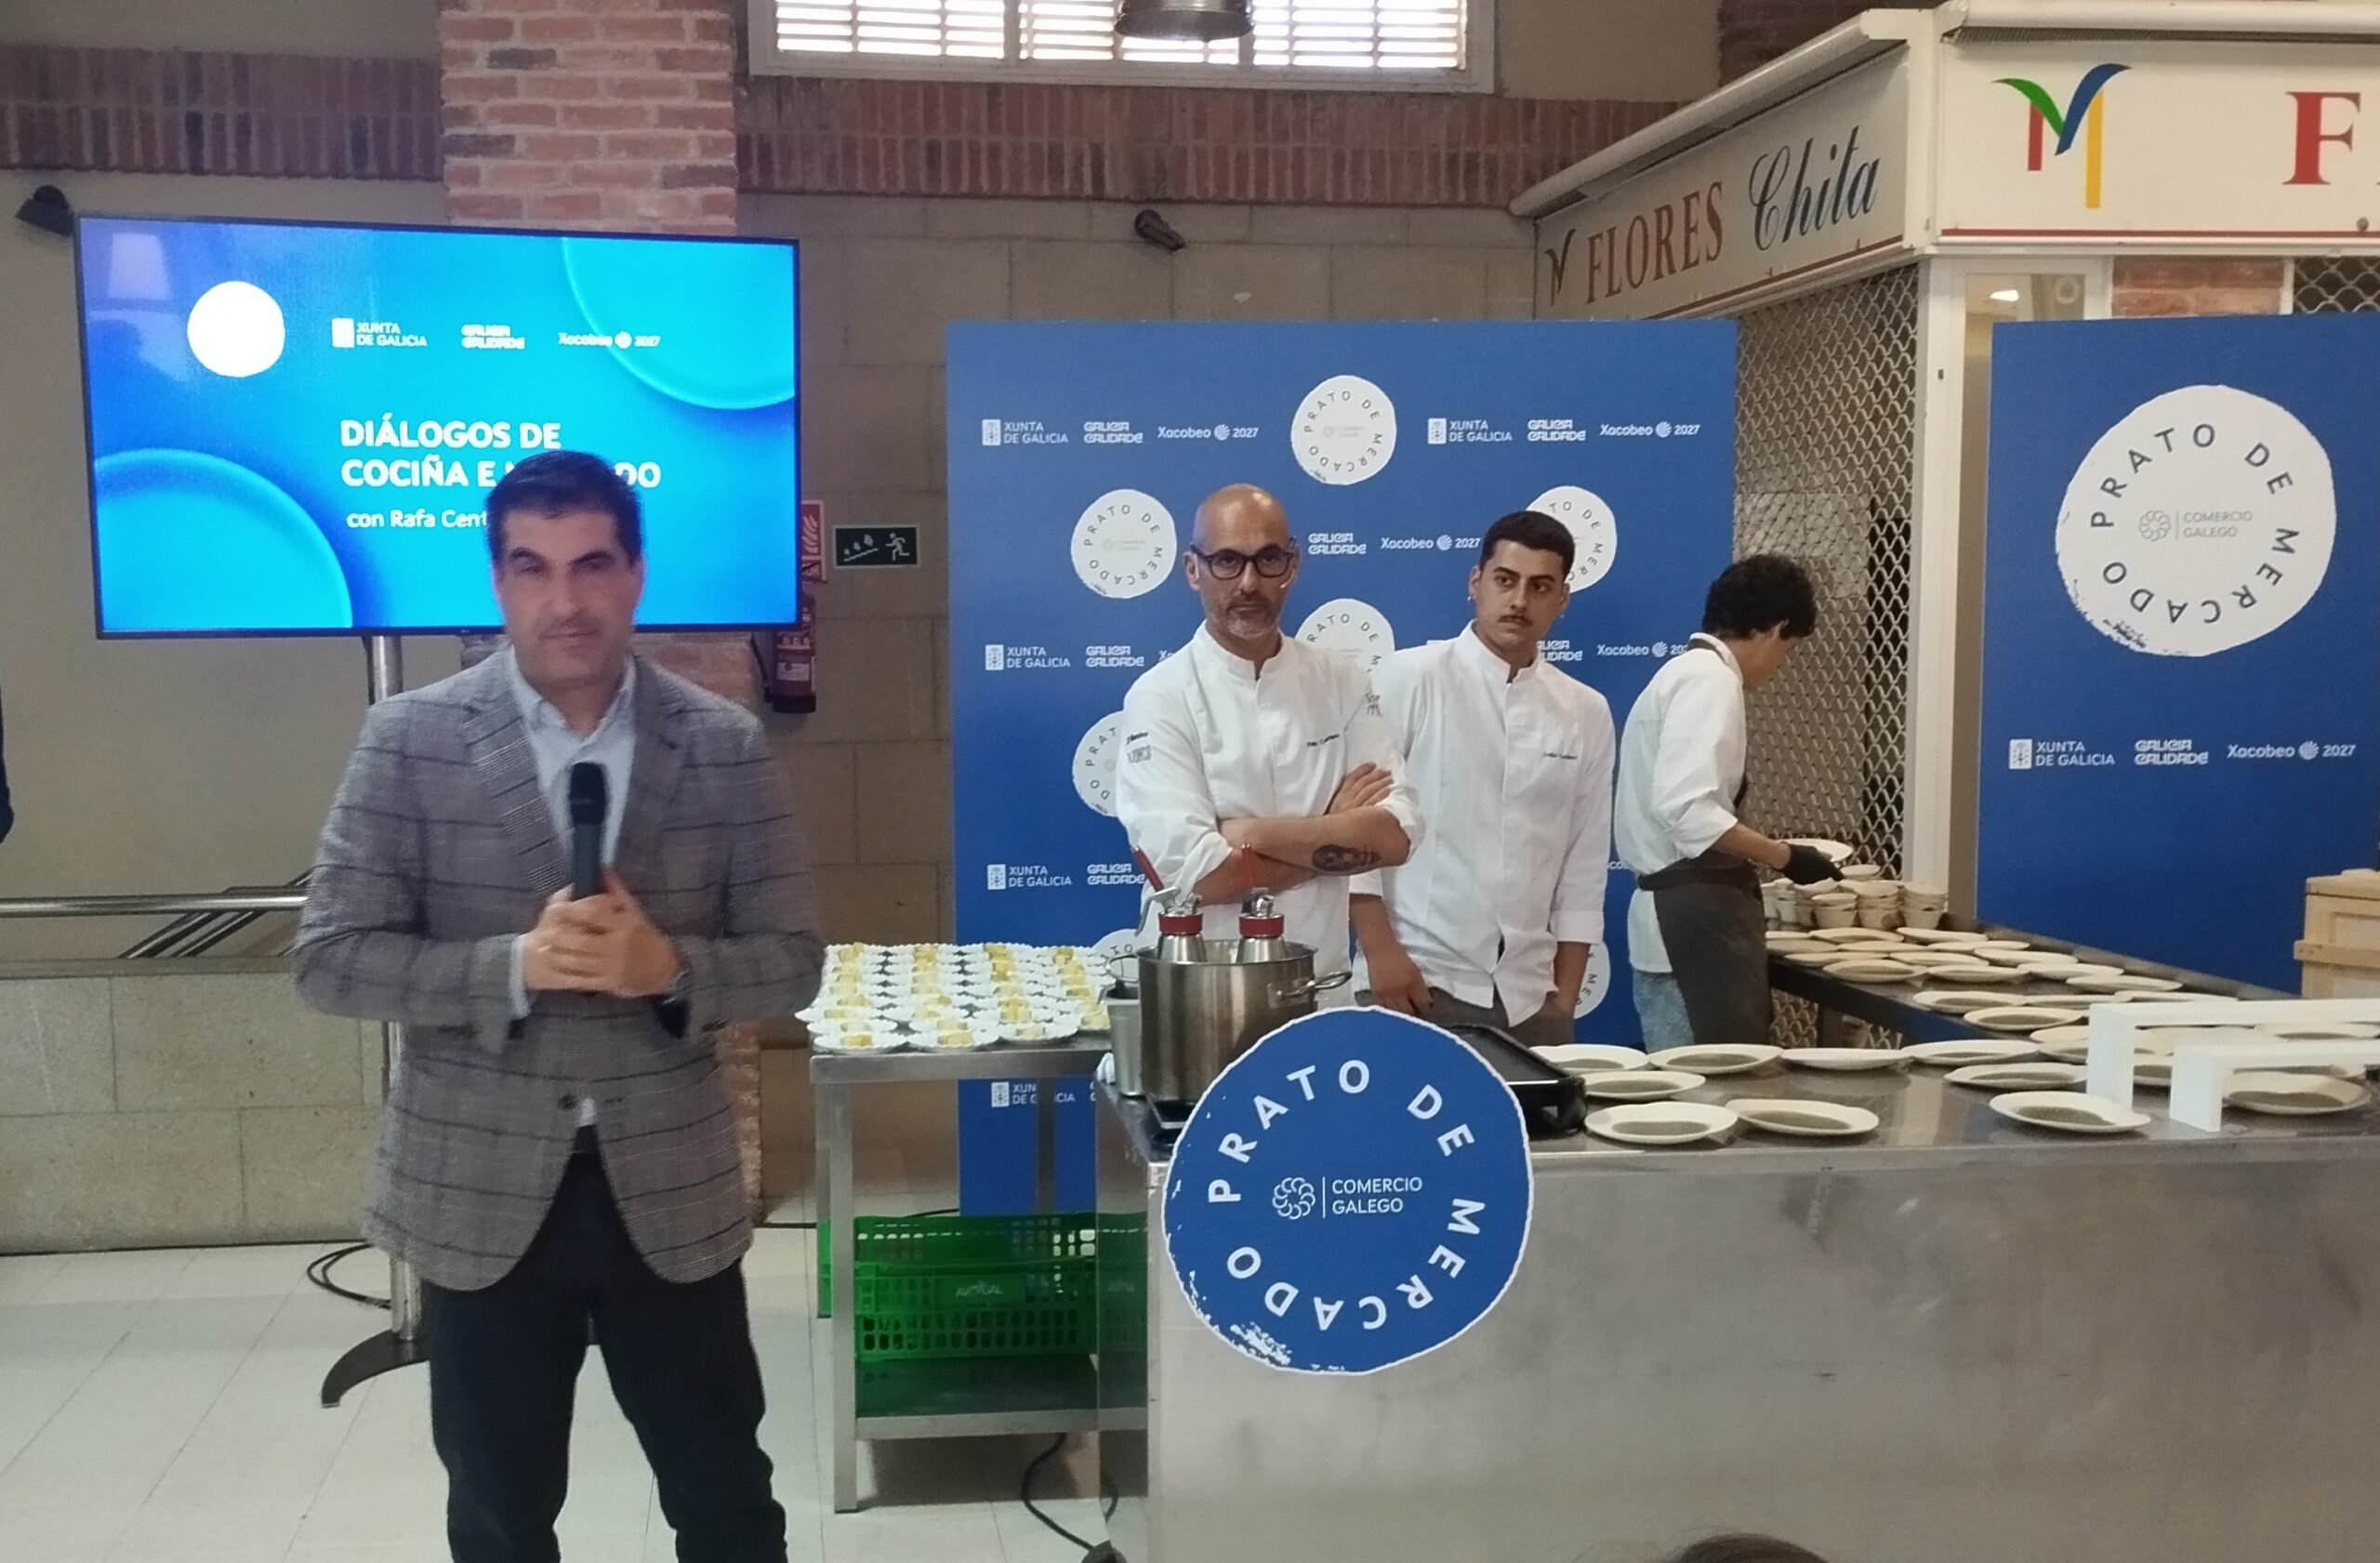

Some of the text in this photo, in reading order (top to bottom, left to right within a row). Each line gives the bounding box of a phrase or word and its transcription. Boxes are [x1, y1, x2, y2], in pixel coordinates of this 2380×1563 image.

[2281, 91, 2380, 185] F
[1586, 125, 1882, 305] FLORES Chita
[356, 334, 428, 348] DE GALICIA
[340, 412, 562, 449] DIÁLOGOS DE
[1003, 421, 1044, 432] XUNTA
[1303, 391, 1382, 472] PRATO DE MERCADO
[1448, 419, 1488, 430] XUNTA
[1599, 424, 1700, 436] Xacobeo 2027
[1003, 432, 1069, 444] DE GALICIA
[1157, 426, 1259, 439] Xacobeo 2027
[1448, 430, 1513, 443] DE GALICIA
[340, 454, 469, 487] COCIÑA
[476, 460, 497, 487] E
[347, 509, 488, 528] con Rafa Cent
[1582, 510, 1601, 529] DE
[2090, 423, 2300, 625] PRATO DE MERCADO
[2183, 510, 2253, 524] COMERCIO
[2183, 526, 2238, 538] GALEGO
[1083, 505, 1163, 586] PRATO DE MERCADO
[1380, 537, 1482, 550] Xacobeo 2027
[1568, 543, 1604, 581] MERC
[1306, 613, 1379, 642] RATO DE
[1007, 646, 1047, 656] XUNTA
[1536, 640, 1570, 650] ALICIA
[1597, 643, 1649, 656] Xacobeo
[1007, 657, 1071, 669] DE GALICIA
[1541, 651, 1583, 661] LIDADE
[1086, 727, 1117, 767] PRAT
[2036, 740, 2086, 753] XUNTA
[2227, 744, 2357, 759] Xacobeo 2027
[2035, 753, 2115, 767] DE GALICIA
[1009, 866, 1049, 876] XUNTA
[1009, 876, 1073, 887] DE GALICIA
[1012, 1083, 1037, 1093] XUN
[1012, 1093, 1027, 1105] DE
[1332, 1176, 1423, 1195] COMERCIO
[1209, 1060, 1486, 1331] PRATO DE MERCADO
[1332, 1198, 1404, 1215] GALEGO
